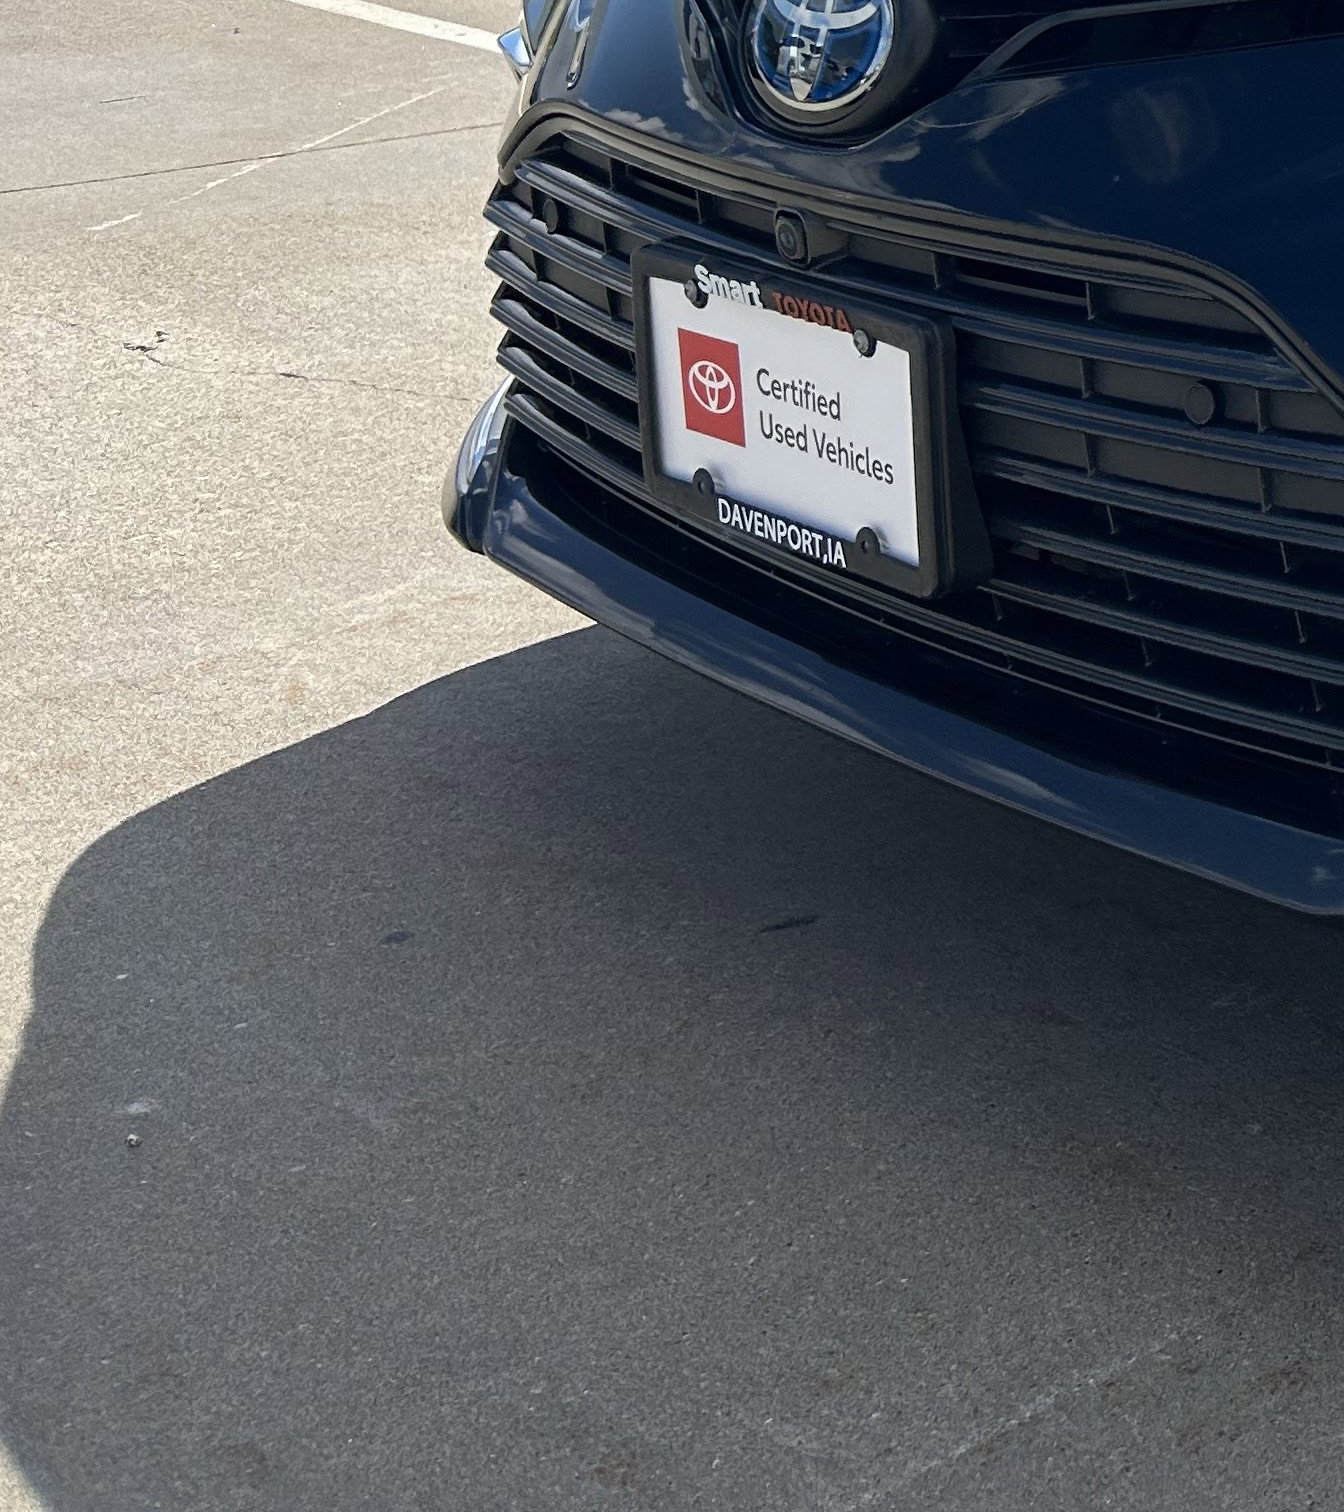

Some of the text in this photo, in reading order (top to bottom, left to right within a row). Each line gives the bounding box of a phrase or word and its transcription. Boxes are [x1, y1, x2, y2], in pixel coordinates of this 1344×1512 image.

[694, 264, 852, 332] Smart TOYOTA
[756, 368, 841, 421] Certified
[759, 410, 894, 485] Used Vehicles
